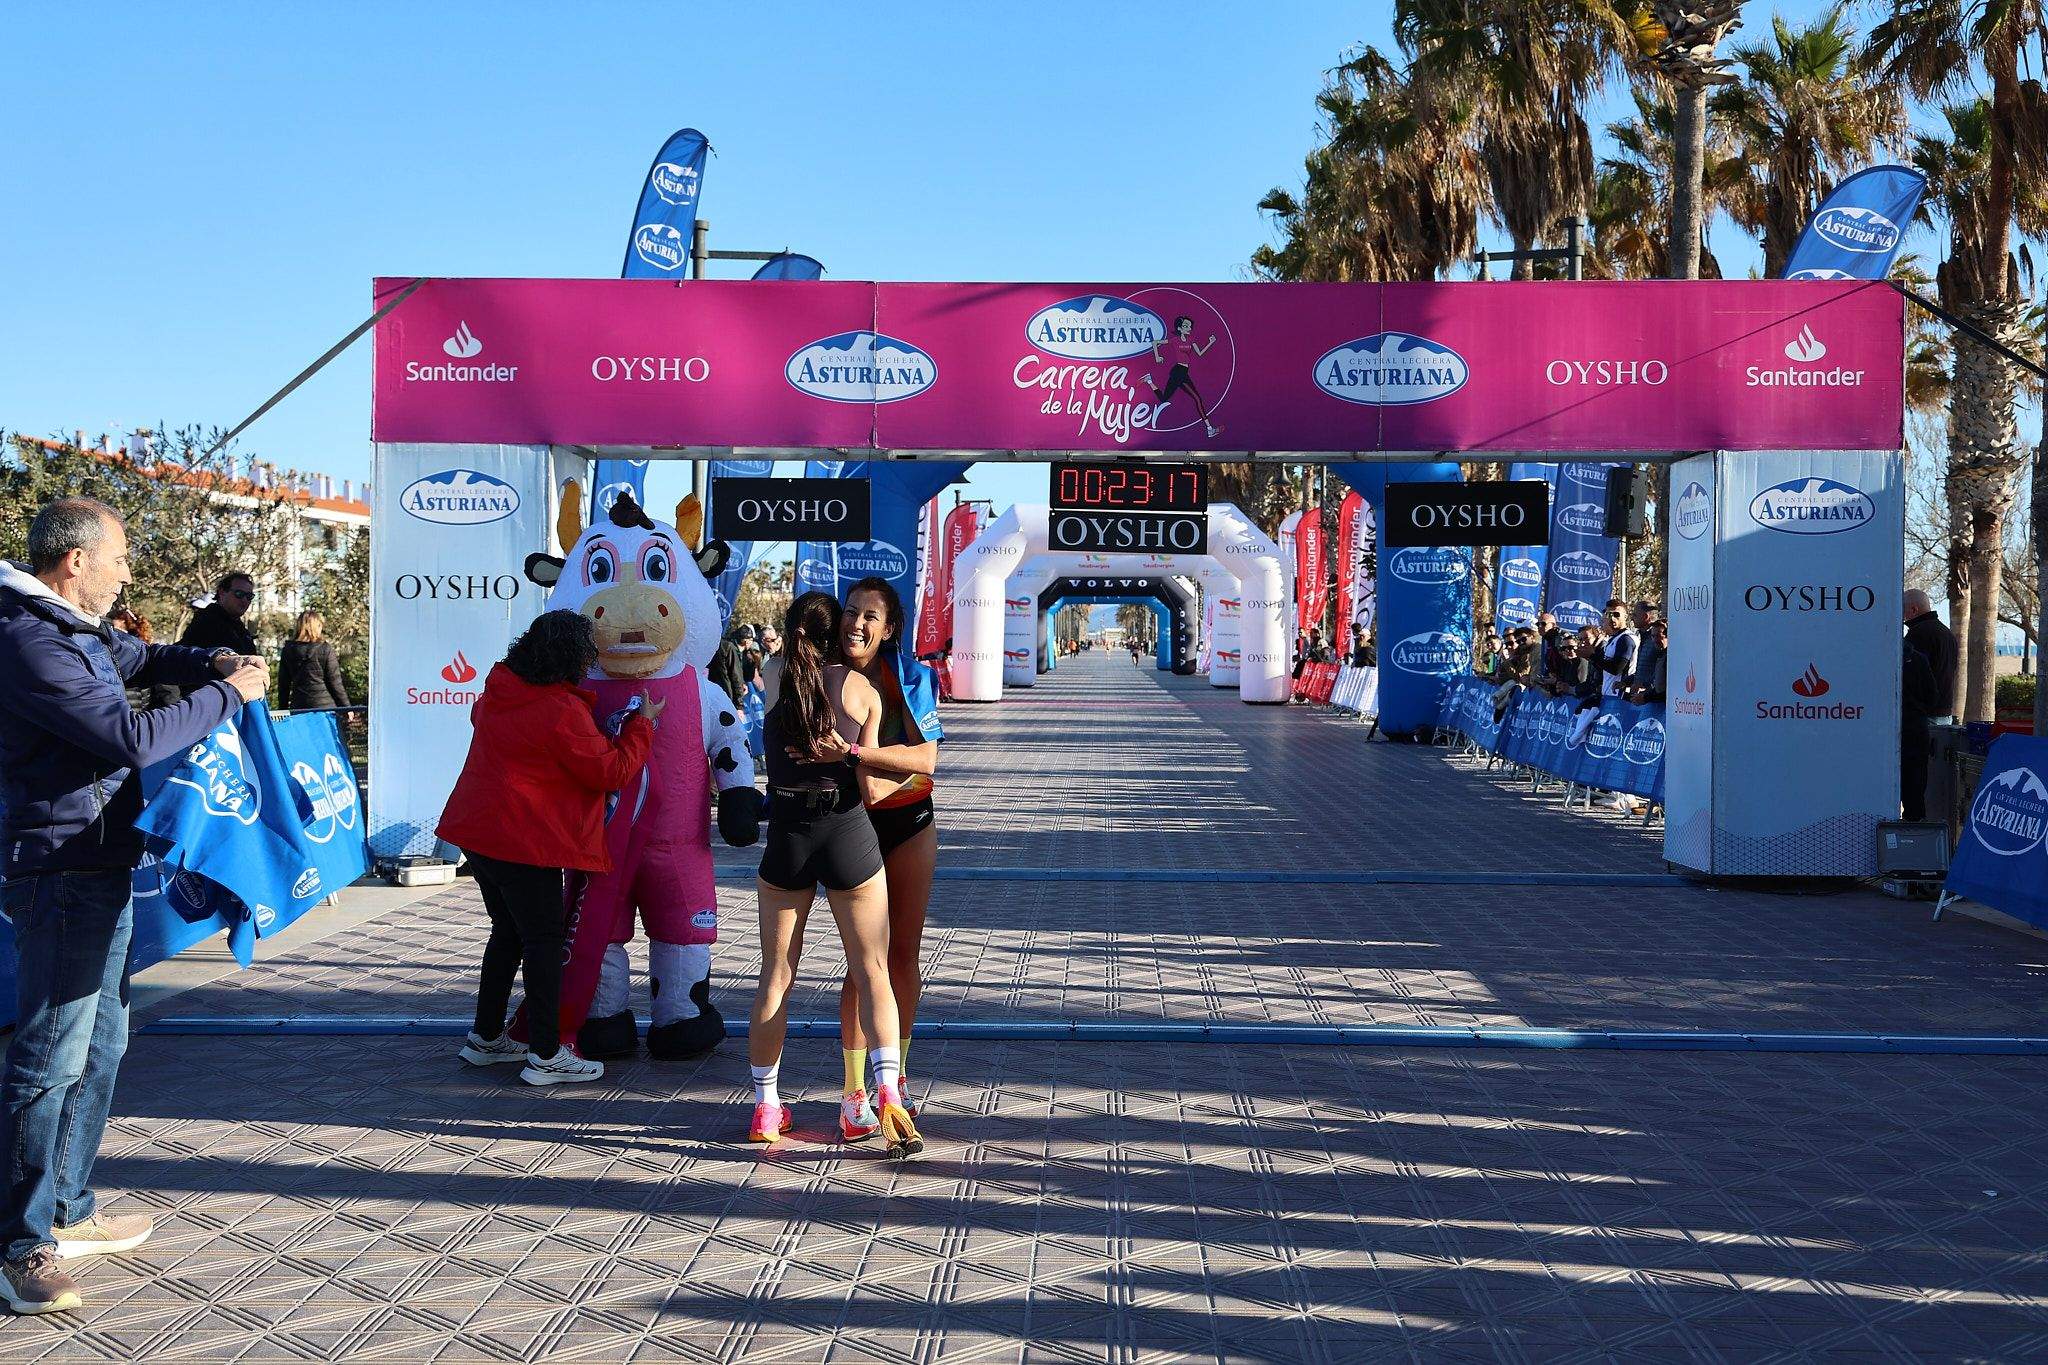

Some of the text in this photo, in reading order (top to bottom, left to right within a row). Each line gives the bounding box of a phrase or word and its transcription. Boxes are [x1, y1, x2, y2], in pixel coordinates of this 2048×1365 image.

[1037, 317, 1155, 343] ASTURIANA
[406, 361, 518, 383] Santander
[591, 355, 711, 383] OYSHO
[797, 357, 926, 385] ASTURIANA
[820, 355, 921, 364] CENTRAL LECHERA
[1013, 354, 1128, 390] Carrera
[1325, 359, 1456, 386] ASTURIANA
[1349, 357, 1451, 365] CENTRAL LECHERA
[1546, 359, 1668, 386] OYSHO
[1746, 365, 1865, 387] Santander
[1040, 387, 1171, 443] de la Mujer
[1060, 469, 1198, 503] 00:23:17
[409, 489, 511, 511] ASTURIANA
[737, 499, 848, 522] OYSHO
[1758, 498, 1866, 520] ASTURIANA
[1411, 503, 1525, 528] OYSHO
[1056, 516, 1200, 549] OYSHO
[1346, 506, 1361, 580] Santander
[977, 546, 1017, 555] OYSHO
[1225, 545, 1266, 554] OYSHO
[1305, 527, 1316, 589] Santander
[1557, 560, 1607, 578] ASTURIANA
[395, 573, 520, 600] OYSHO
[1069, 579, 1148, 588] VOLVO
[1673, 584, 1709, 612] OYSHO
[1744, 585, 1875, 612] OYSHO
[925, 599, 938, 643] Sports
[1674, 697, 1705, 716] Santander
[1756, 702, 1865, 720] Santander
